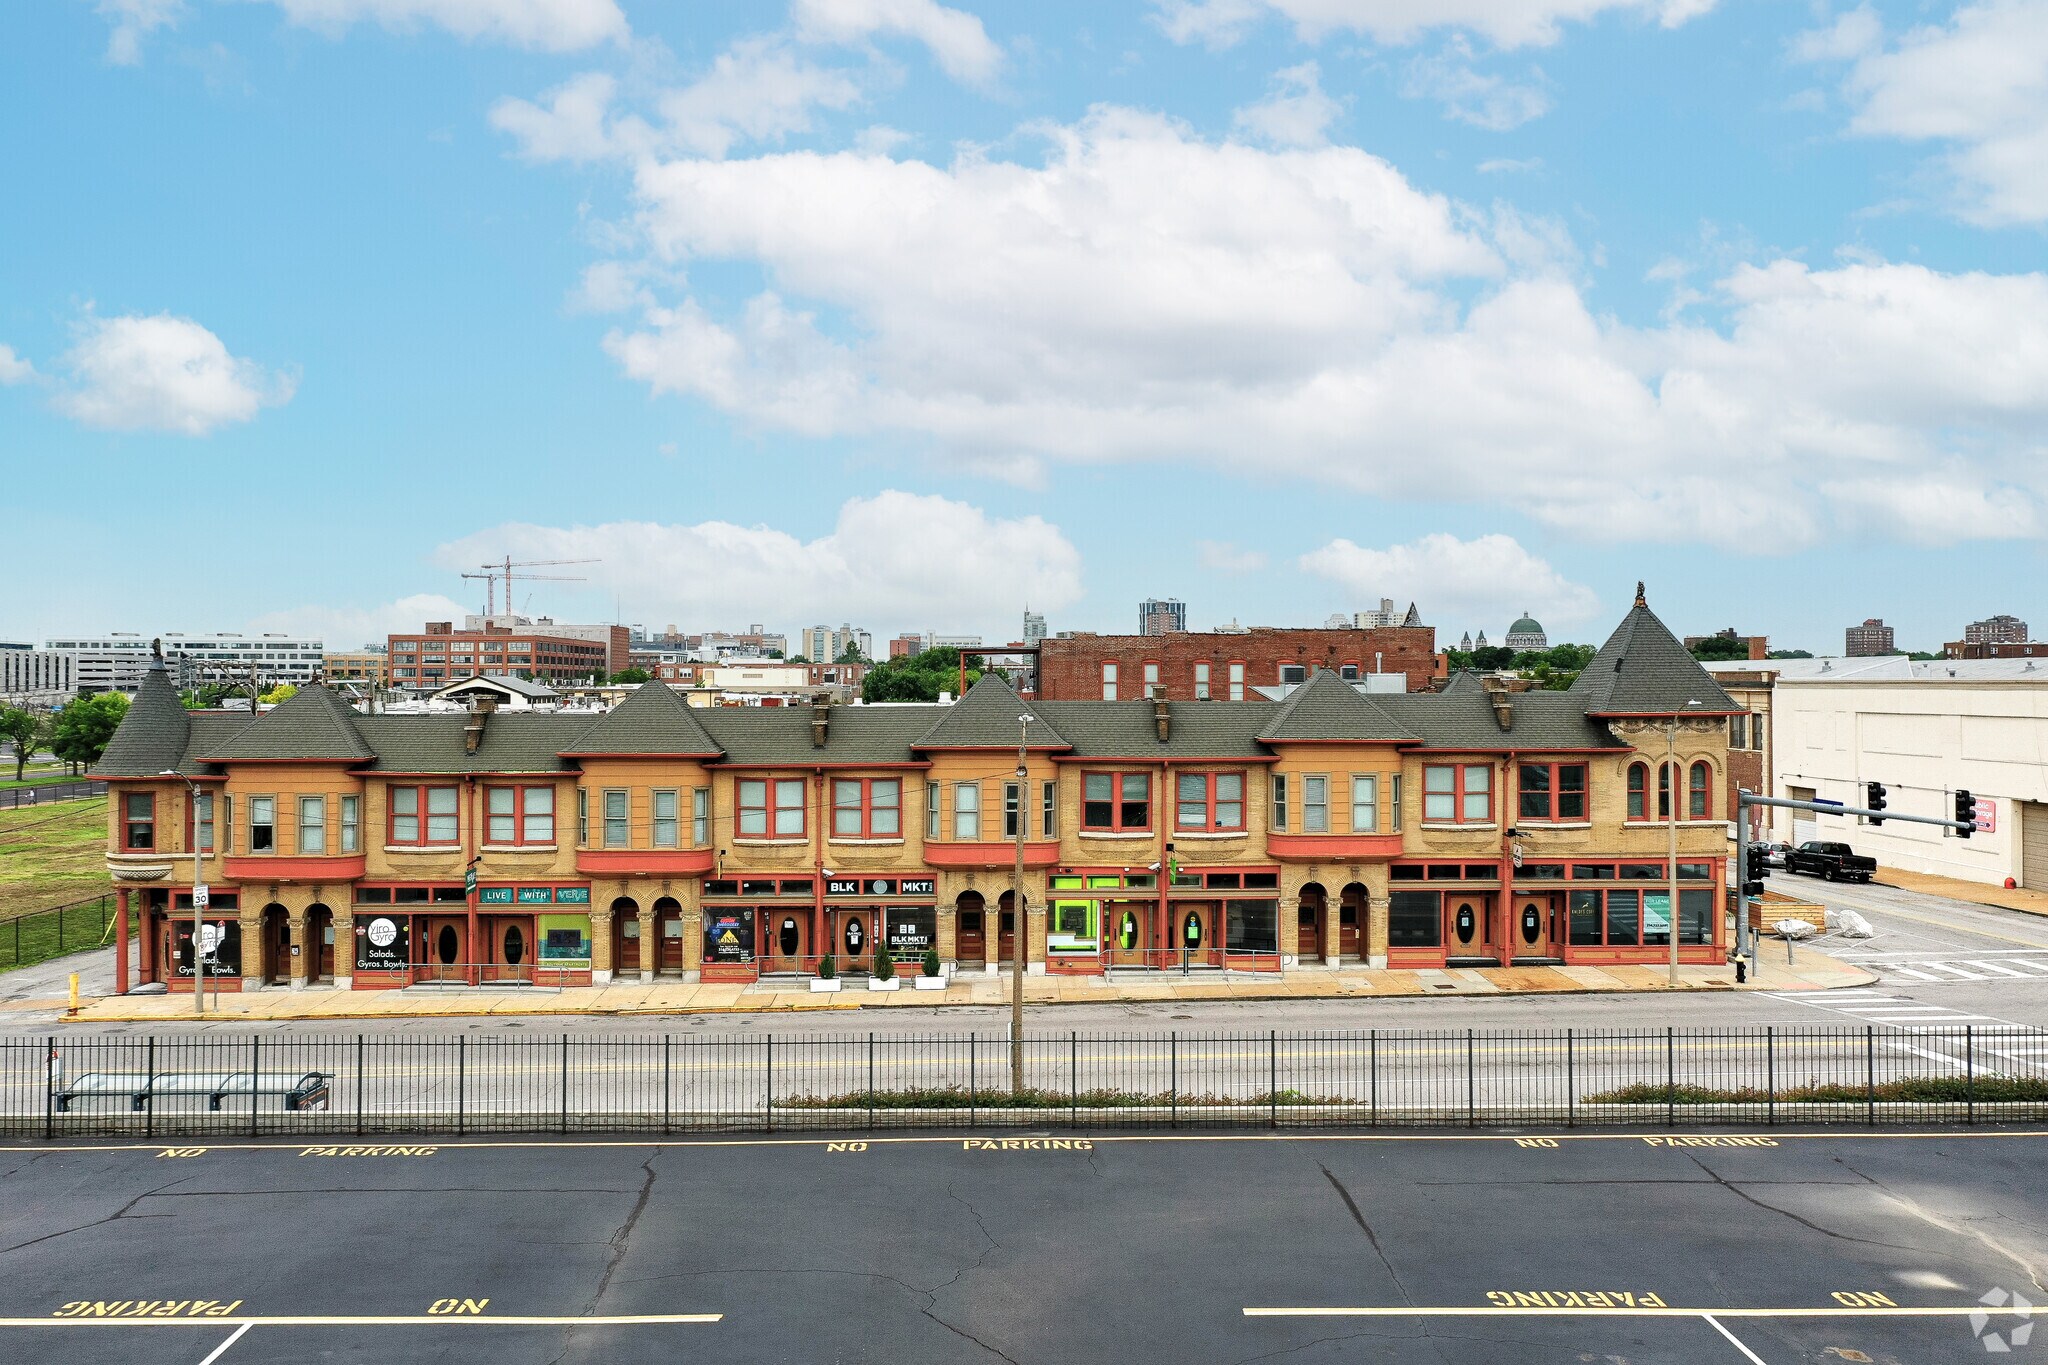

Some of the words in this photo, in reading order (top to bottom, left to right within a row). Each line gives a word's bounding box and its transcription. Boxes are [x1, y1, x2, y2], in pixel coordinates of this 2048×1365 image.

[830, 882, 855, 891] BLK
[902, 882, 928, 891] MKT
[195, 895, 206, 903] 30
[524, 891, 546, 899] WITH
[369, 950, 396, 958] Salads.
[357, 960, 382, 969] Gyros.
[383, 959, 408, 967] Bowls.
[826, 1142, 868, 1152] NO
[963, 1140, 1093, 1150] PARKING
[1513, 1138, 1559, 1148] NO
[1642, 1137, 1779, 1147] PARKING
[156, 1148, 207, 1158] NO
[299, 1147, 439, 1157] PARKING
[1486, 1290, 1668, 1308] PARKING
[1831, 1291, 1897, 1307] NO
[53, 1299, 244, 1317] PARKING
[427, 1298, 490, 1315] NO
